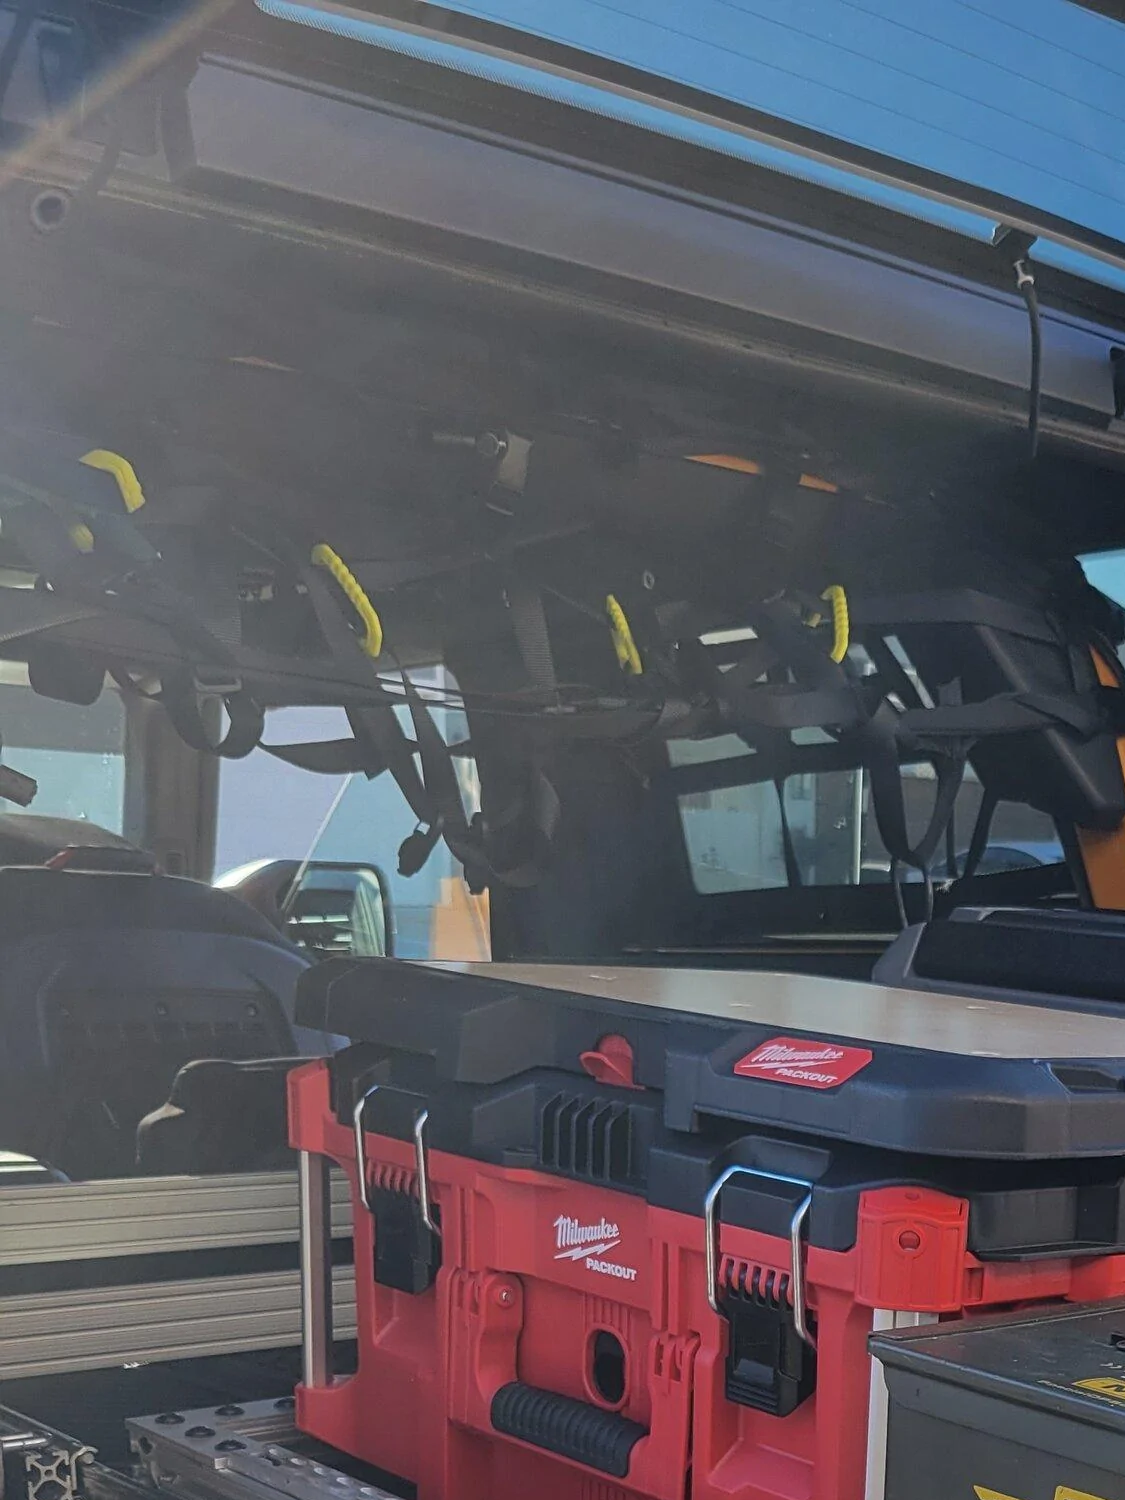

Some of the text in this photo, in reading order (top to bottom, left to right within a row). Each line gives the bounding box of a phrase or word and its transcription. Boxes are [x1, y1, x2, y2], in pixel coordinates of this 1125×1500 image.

[751, 1044, 844, 1063] Milwaukee
[774, 1068, 839, 1083] PACKOUT
[553, 1214, 620, 1249] Milwaukee
[585, 1257, 638, 1281] PACKOUT
